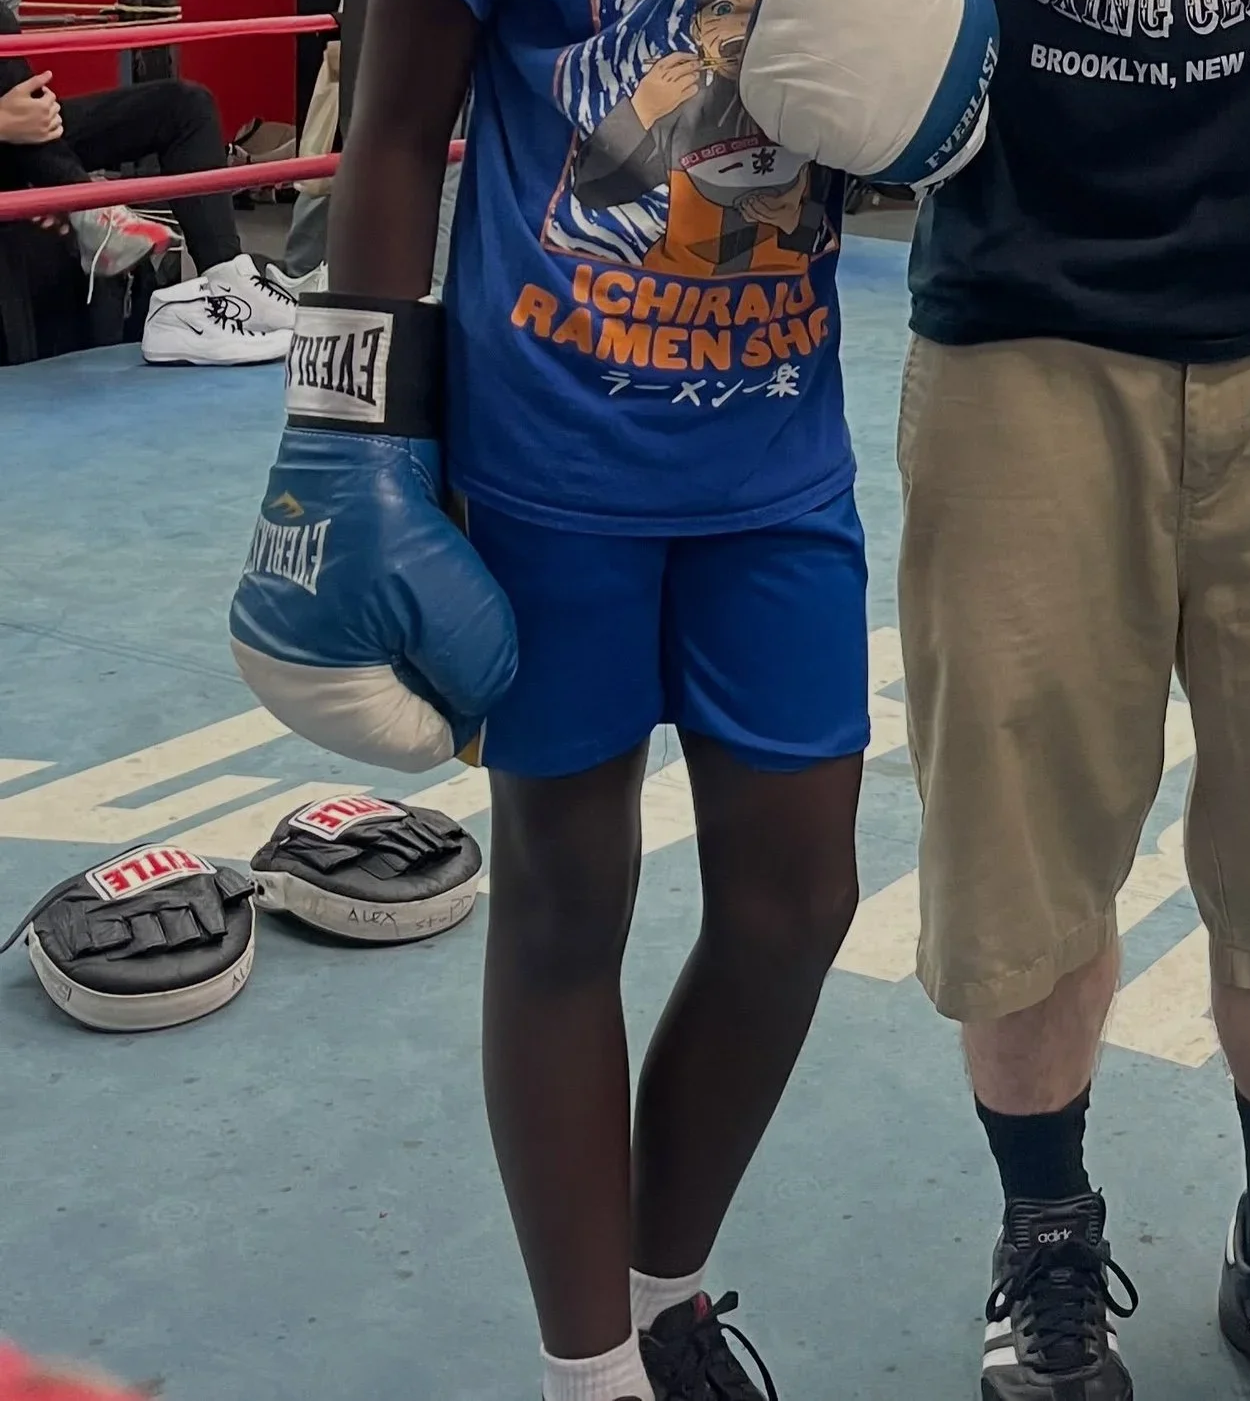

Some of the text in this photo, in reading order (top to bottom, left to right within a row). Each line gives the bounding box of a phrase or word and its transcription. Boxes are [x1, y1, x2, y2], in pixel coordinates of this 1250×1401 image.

[1030, 42, 1178, 90] BROOKLYN,
[1185, 53, 1246, 84] NEW
[510, 283, 734, 371] RAMEN
[102, 847, 203, 893] TITLE
